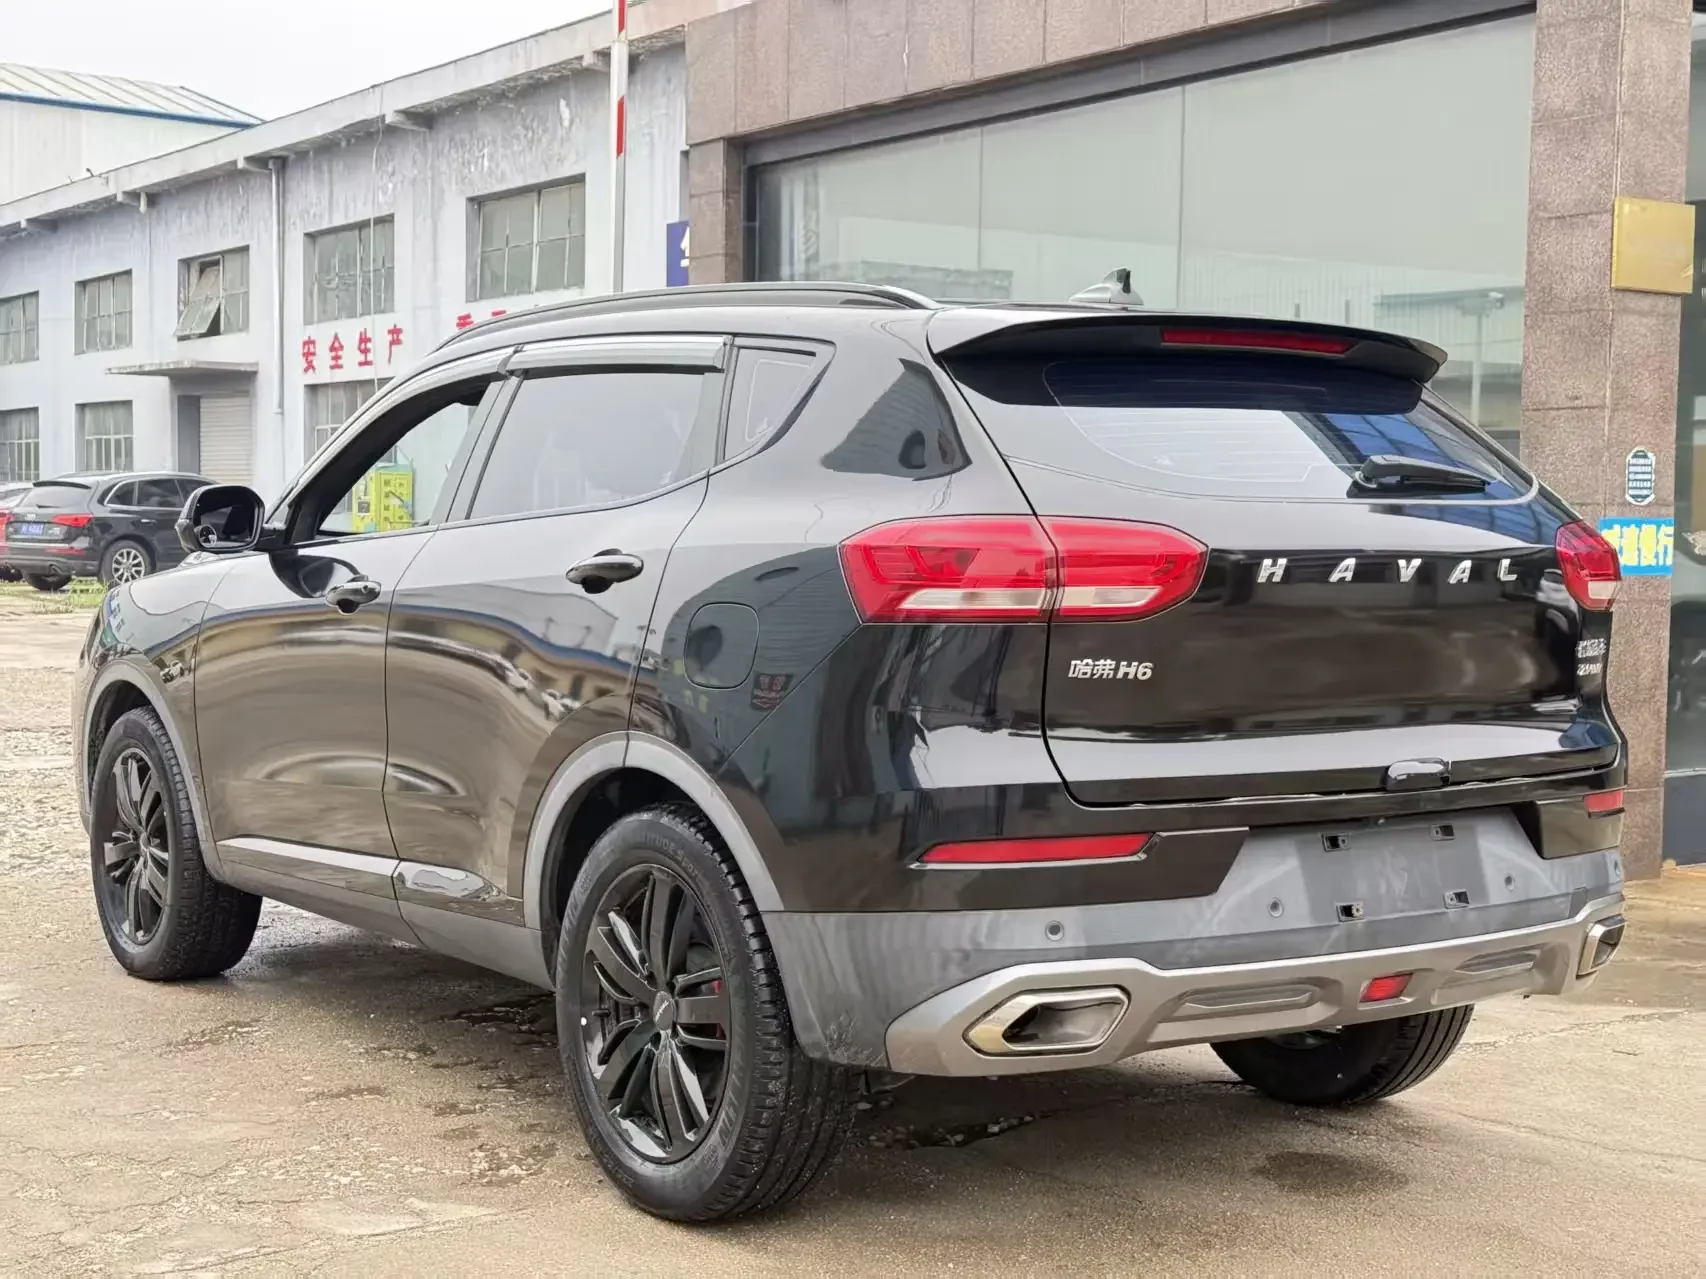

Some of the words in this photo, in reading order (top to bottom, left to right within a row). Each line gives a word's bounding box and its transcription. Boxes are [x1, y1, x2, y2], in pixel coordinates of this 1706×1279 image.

[302, 324, 404, 373] 安全生产
[1257, 557, 1518, 584] HAVAL
